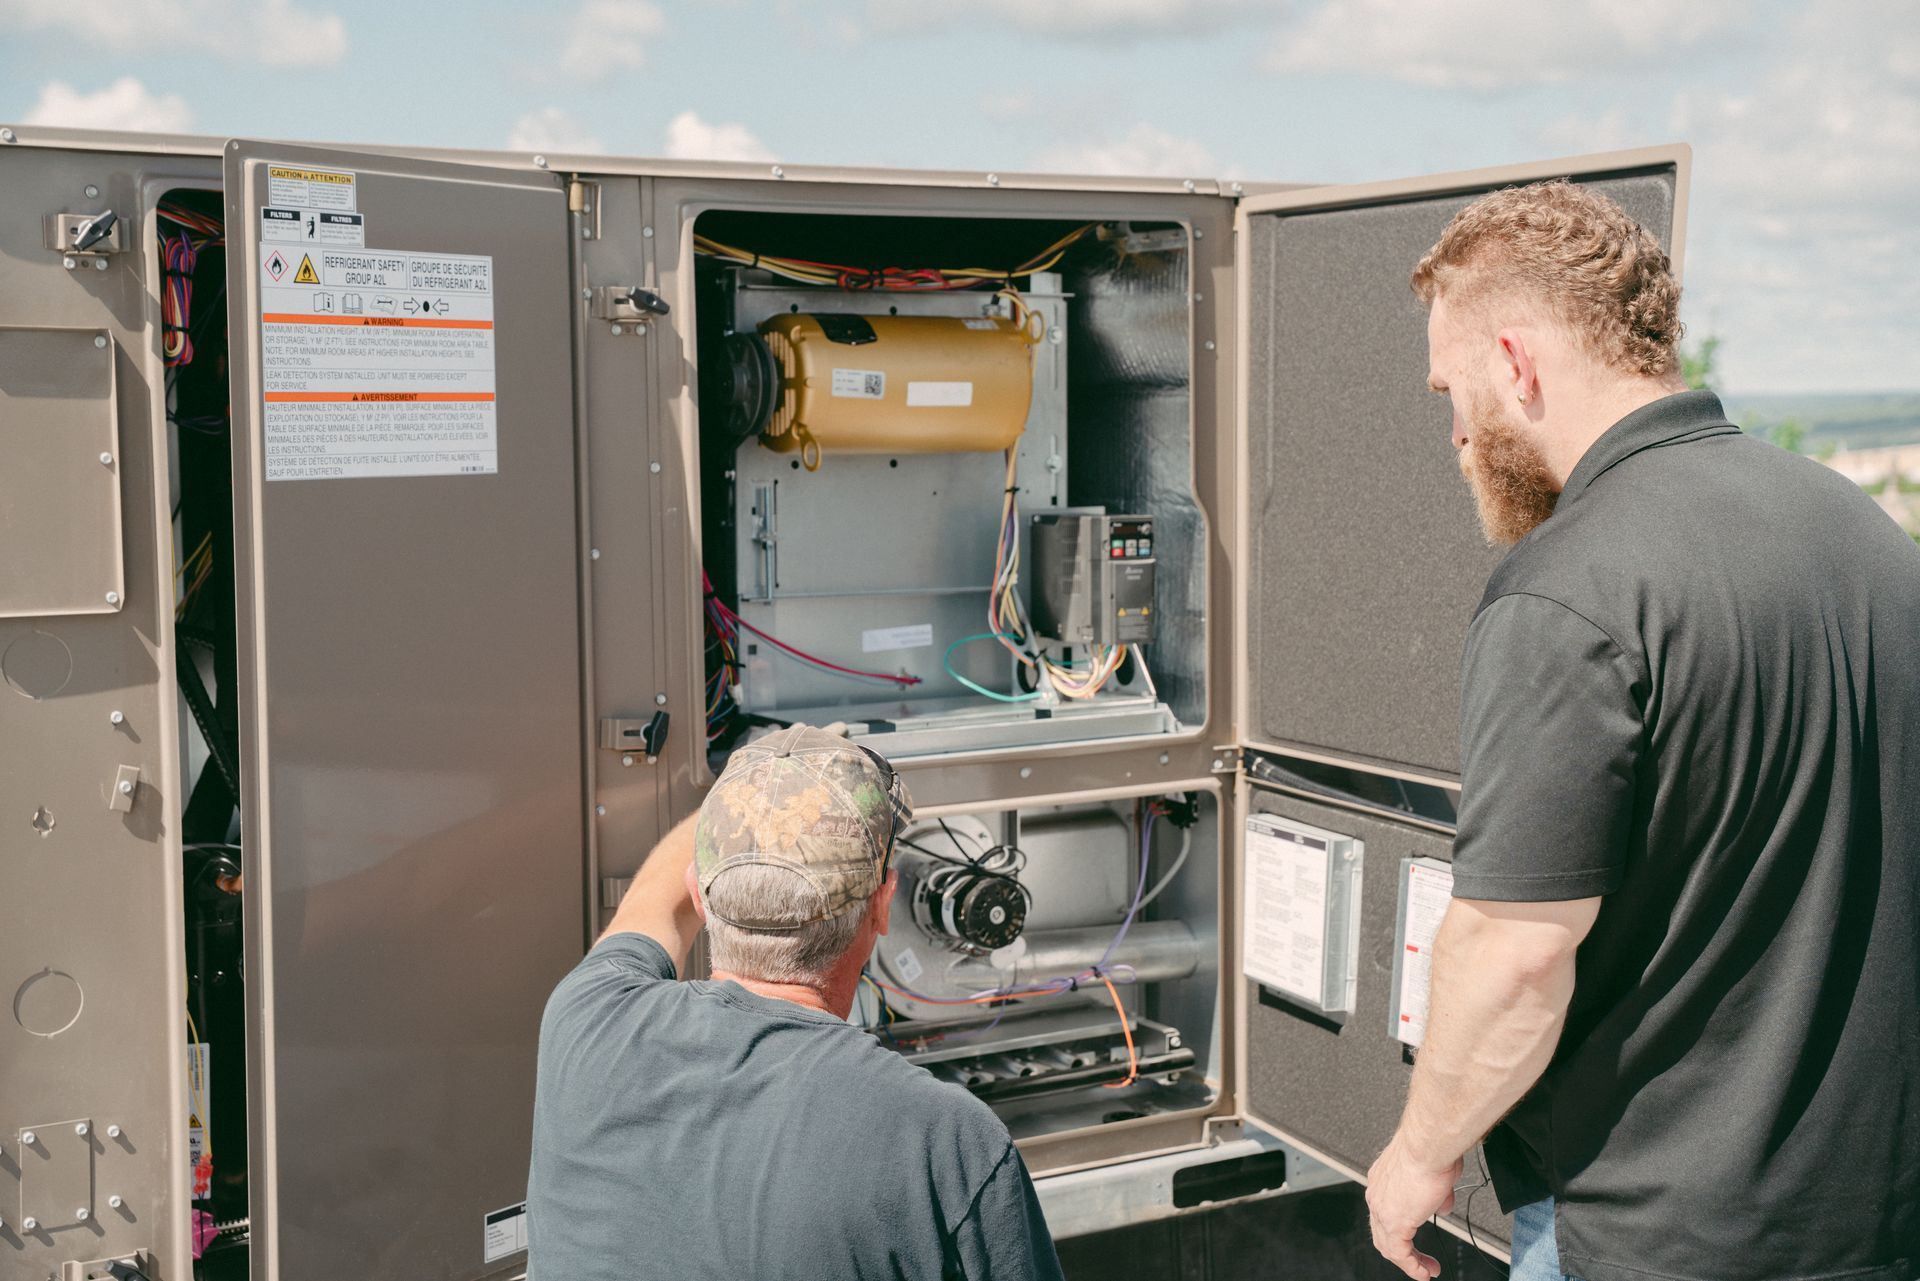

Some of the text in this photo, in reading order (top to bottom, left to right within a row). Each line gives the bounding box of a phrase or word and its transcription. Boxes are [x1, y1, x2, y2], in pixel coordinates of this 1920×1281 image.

[272, 170, 302, 178] CAUTION
[310, 174, 352, 183] ATTENTION
[270, 211, 293, 219] FILTERS
[325, 256, 404, 272] REFRIGERANT SAFETY
[412, 261, 441, 274] GROUPE
[443, 264, 453, 275] DE
[346, 272, 387, 286] GROUP A2L
[413, 276, 422, 288] DU
[475, 279, 487, 290] A2L
[371, 318, 404, 326] WARNING
[295, 326, 336, 334] INSTALLATION
[437, 330, 451, 338] AREA
[265, 336, 275, 344] OR
[358, 338, 400, 346] INSTRUCTIONS
[414, 339, 438, 347] MINIMUM
[457, 340, 471, 348] AREA
[300, 347, 326, 355] MINIMUM
[400, 349, 437, 357] INSTALLATION
[266, 370, 281, 379] LEAK
[283, 371, 318, 379] DETECTION
[447, 373, 467, 381] EXCEPT
[361, 393, 418, 401] AVERTISSEMENT
[267, 414, 313, 423] (EXPLOITATION
[268, 435, 301, 444] MINIMALES
[344, 434, 356, 442] DES
[268, 446, 280, 454] LES
[344, 456, 351, 464] DE
[353, 456, 369, 464] FUITE
[269, 469, 285, 477] SAUF
[287, 468, 304, 476] POUR
